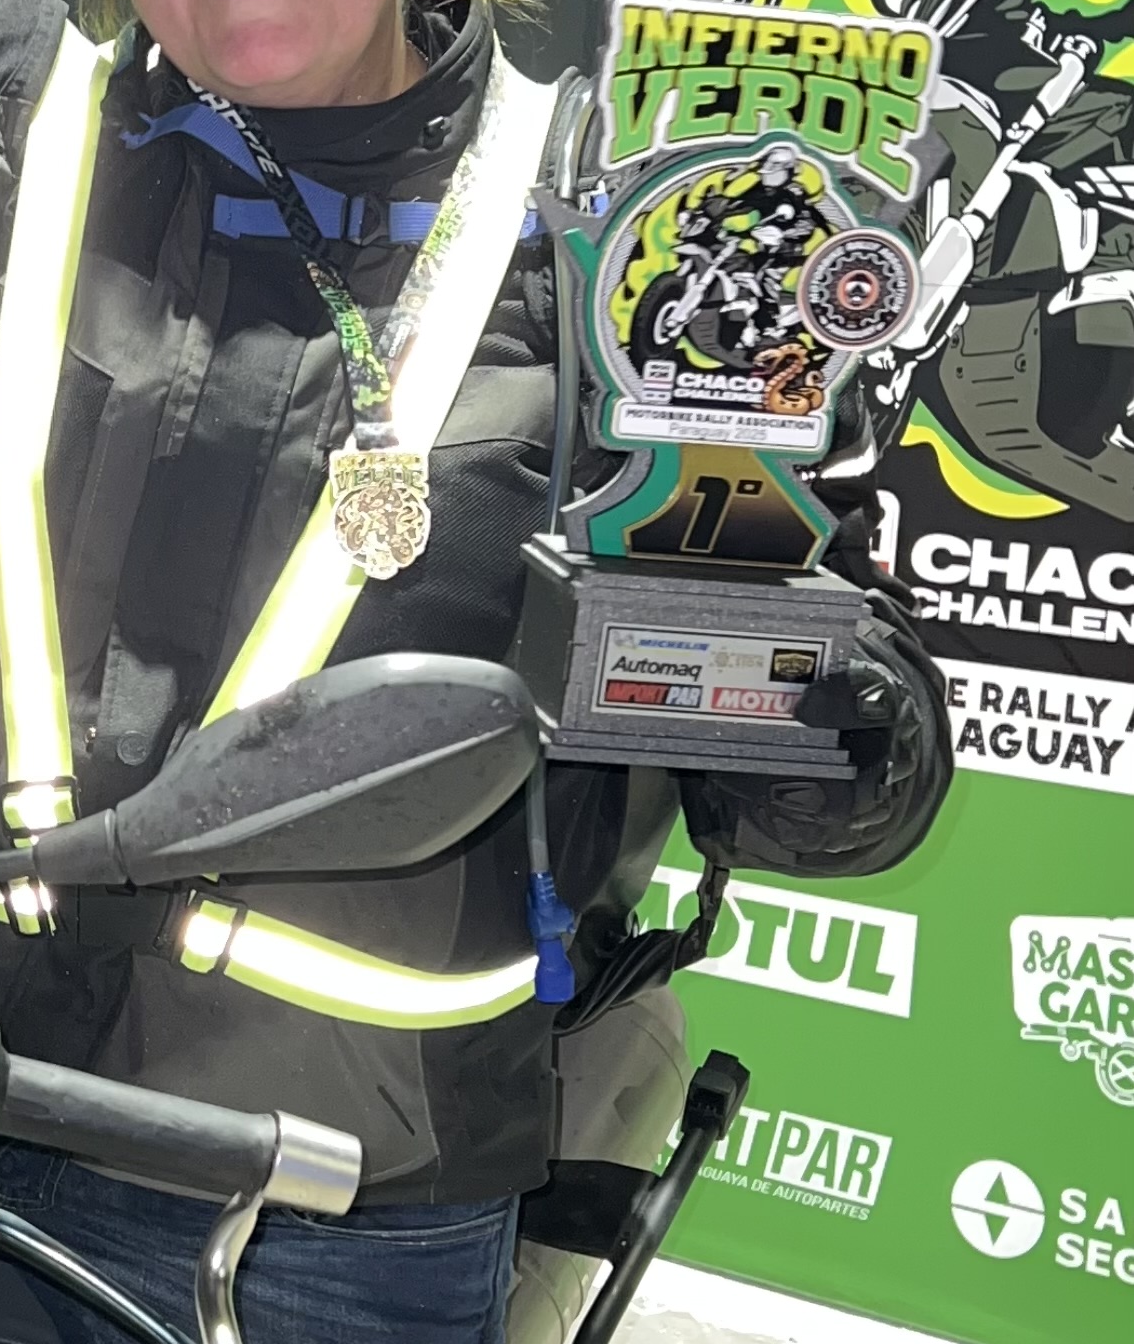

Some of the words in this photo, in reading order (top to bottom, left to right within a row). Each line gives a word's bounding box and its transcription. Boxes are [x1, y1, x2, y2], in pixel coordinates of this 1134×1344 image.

[615, 6, 931, 96] INFIERNO
[610, 67, 922, 196] VERDE
[677, 373, 765, 392] CHACO
[626, 408, 691, 422] MOTORBIKE
[696, 413, 732, 425] RALLY
[736, 416, 815, 431] ASSOCIATION
[669, 422, 731, 441] Paraguay
[911, 533, 1134, 605] CHAC
[638, 639, 710, 651] MICHELIN
[611, 656, 702, 682] Automaq
[716, 689, 801, 713] MOTU
[980, 682, 1111, 728] RALLY
[751, 1178, 770, 1194] DE
[772, 1185, 870, 1221] AUTOPARTES
